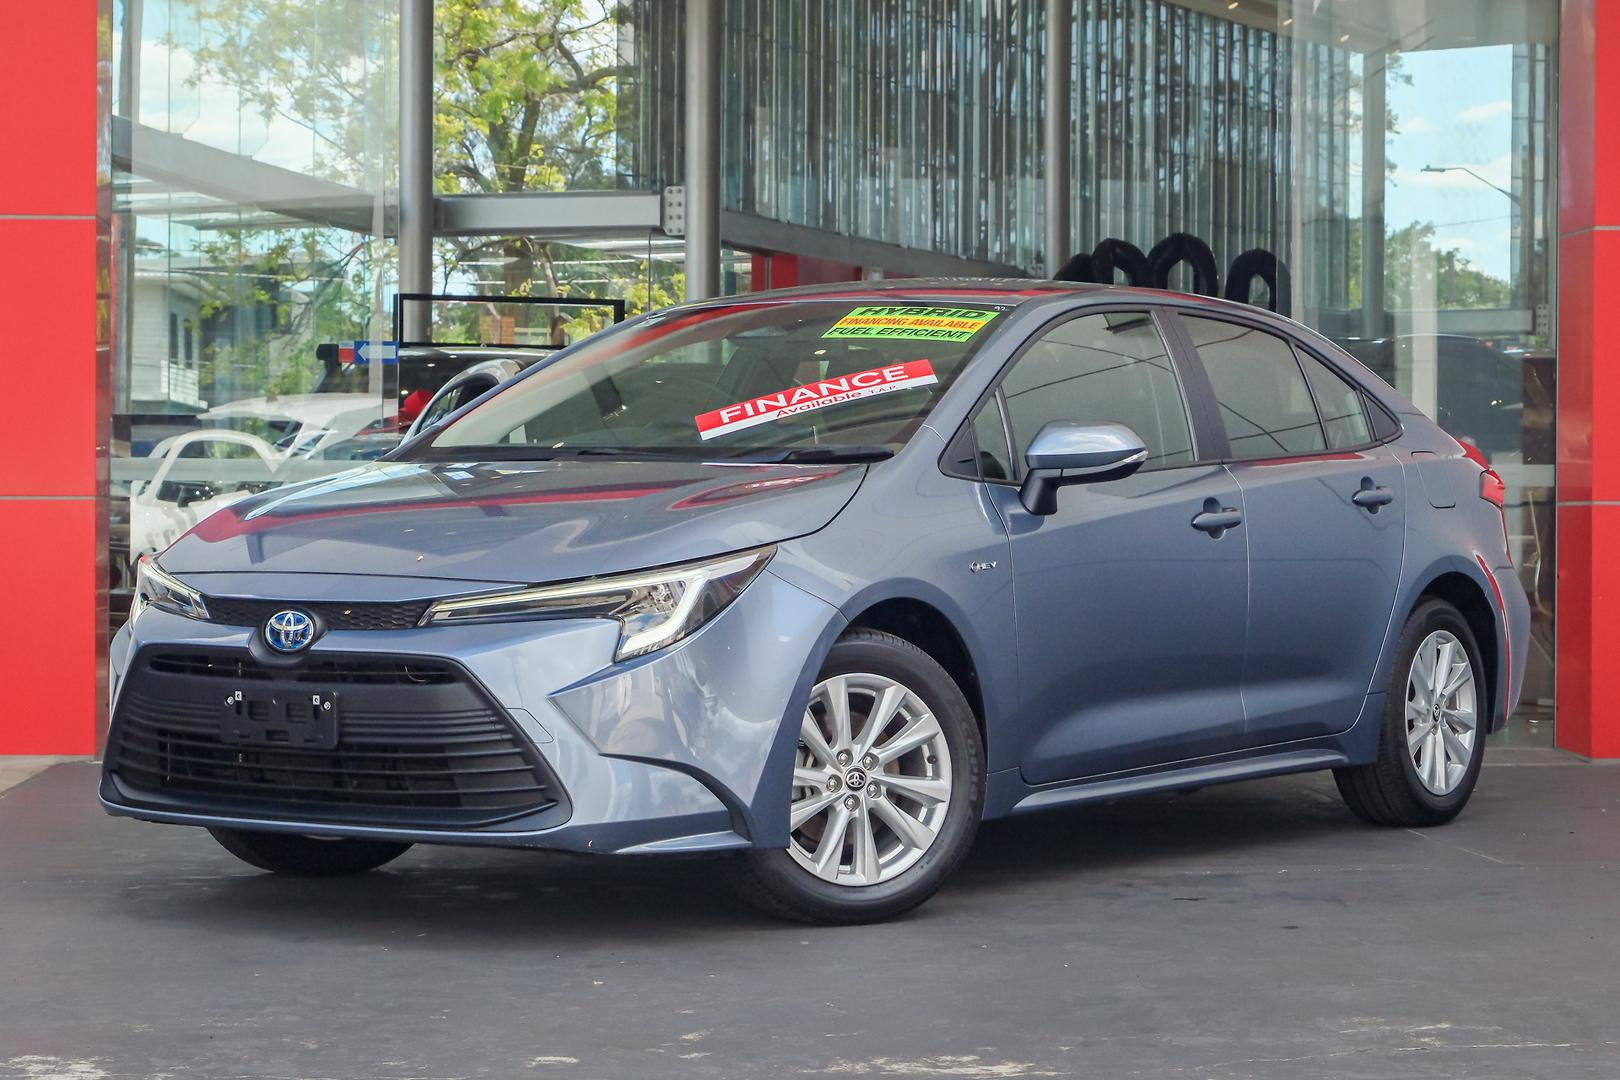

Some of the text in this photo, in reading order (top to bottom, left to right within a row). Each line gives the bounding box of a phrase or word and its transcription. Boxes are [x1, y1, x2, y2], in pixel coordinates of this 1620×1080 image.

[857, 307, 986, 318] HYBRID
[840, 317, 981, 329] FINANCING AVAILABLE
[827, 327, 973, 338] FUEL EFFICIENT
[719, 365, 909, 424] FINANCE
[775, 391, 863, 418] Available
